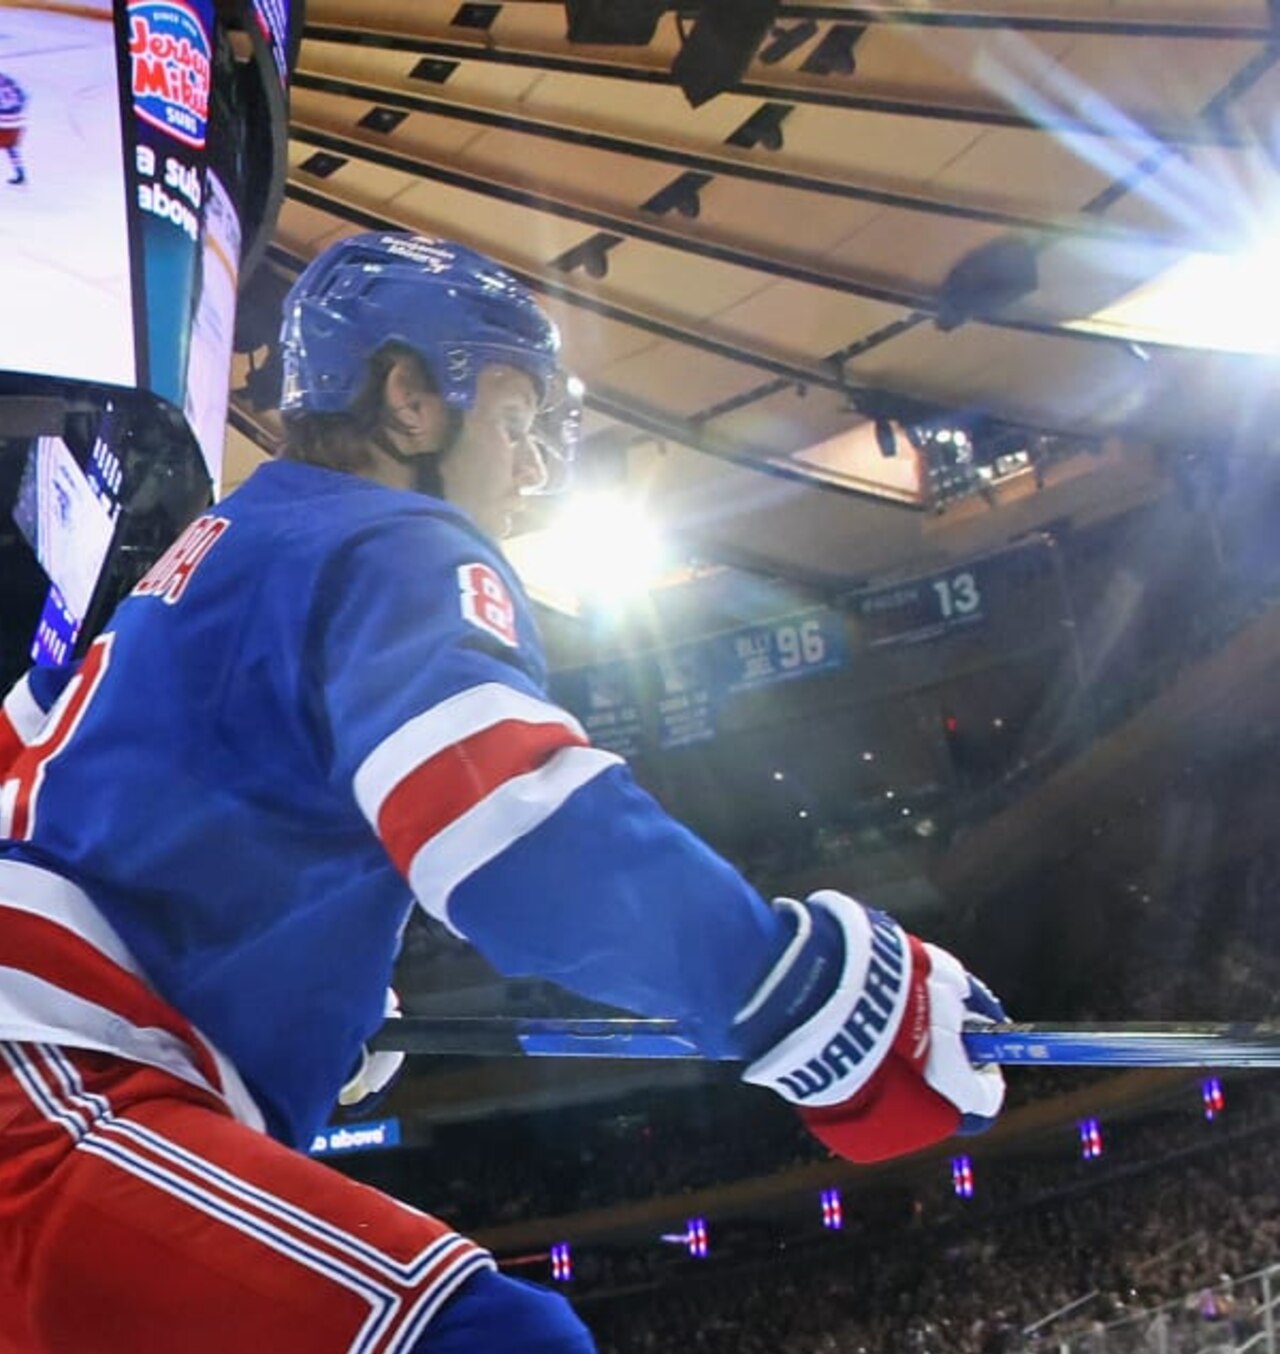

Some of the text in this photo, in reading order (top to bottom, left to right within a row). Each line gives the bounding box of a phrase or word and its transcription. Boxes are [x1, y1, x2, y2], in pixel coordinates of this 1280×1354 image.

[136, 145, 202, 209] a sub
[933, 573, 980, 617] 13
[775, 620, 825, 669] 96
